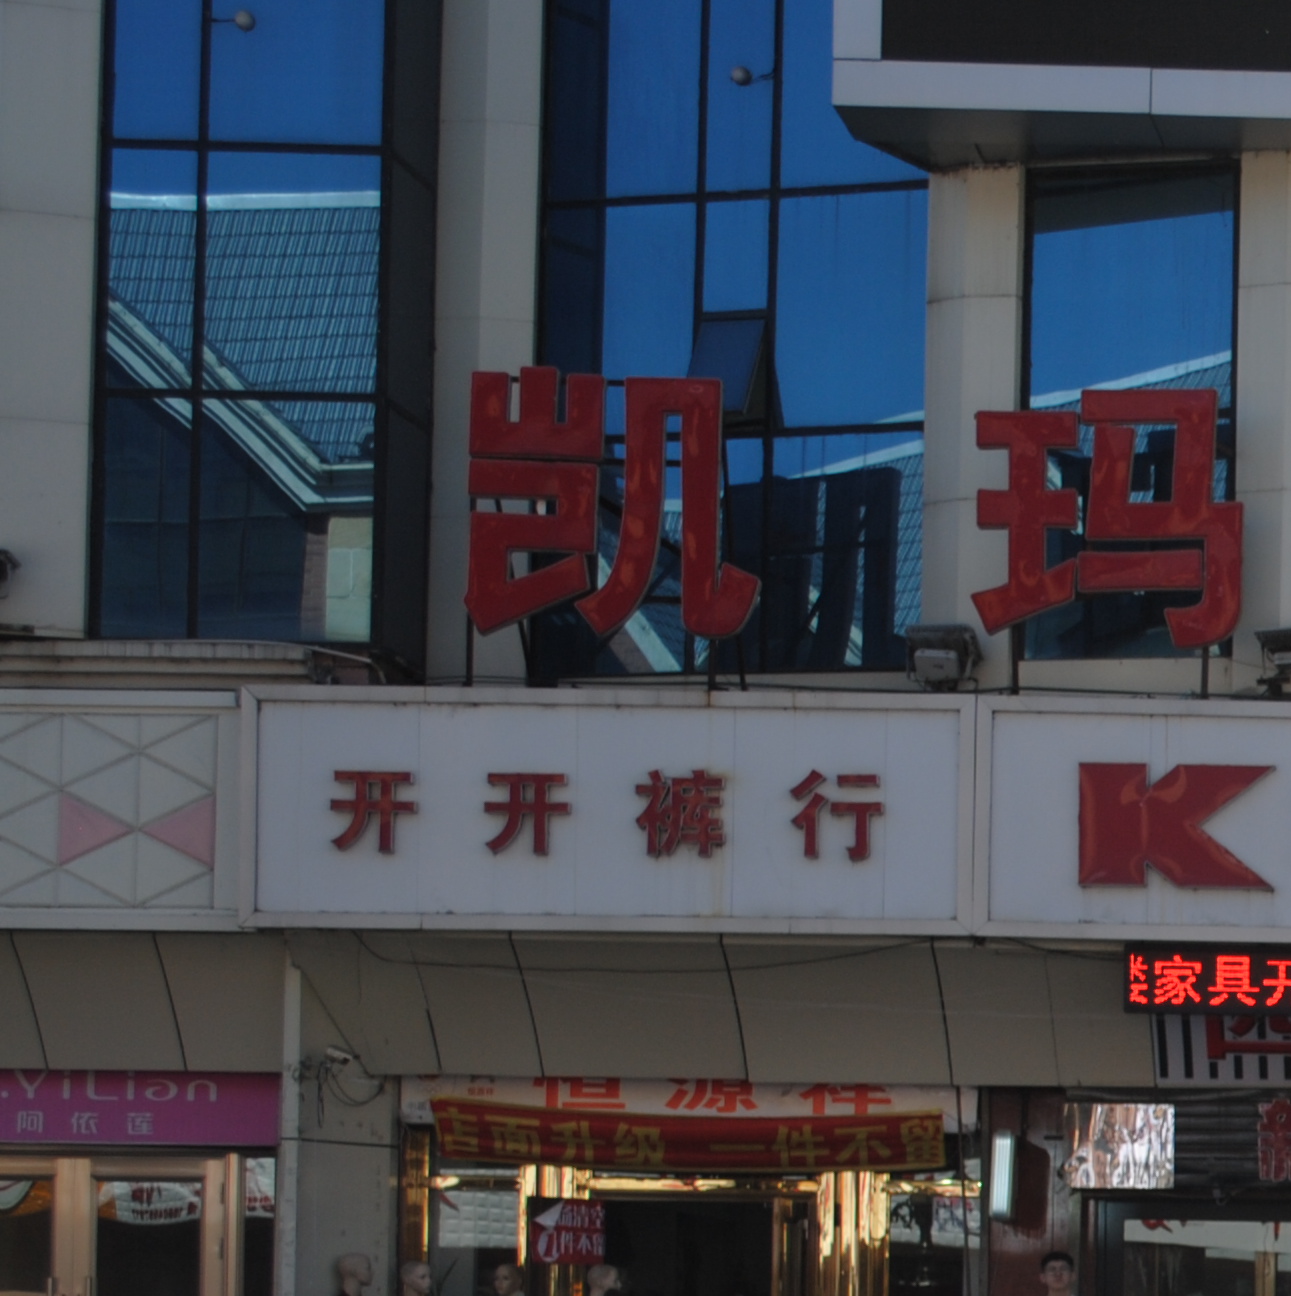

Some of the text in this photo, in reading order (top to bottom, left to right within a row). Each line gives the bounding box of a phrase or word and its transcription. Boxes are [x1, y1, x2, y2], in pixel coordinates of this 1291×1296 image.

[329, 769, 885, 862] 开开裤行
[16, 1110, 154, 1136] 阿依莲
[709, 1118, 946, 1167] 一件不留
